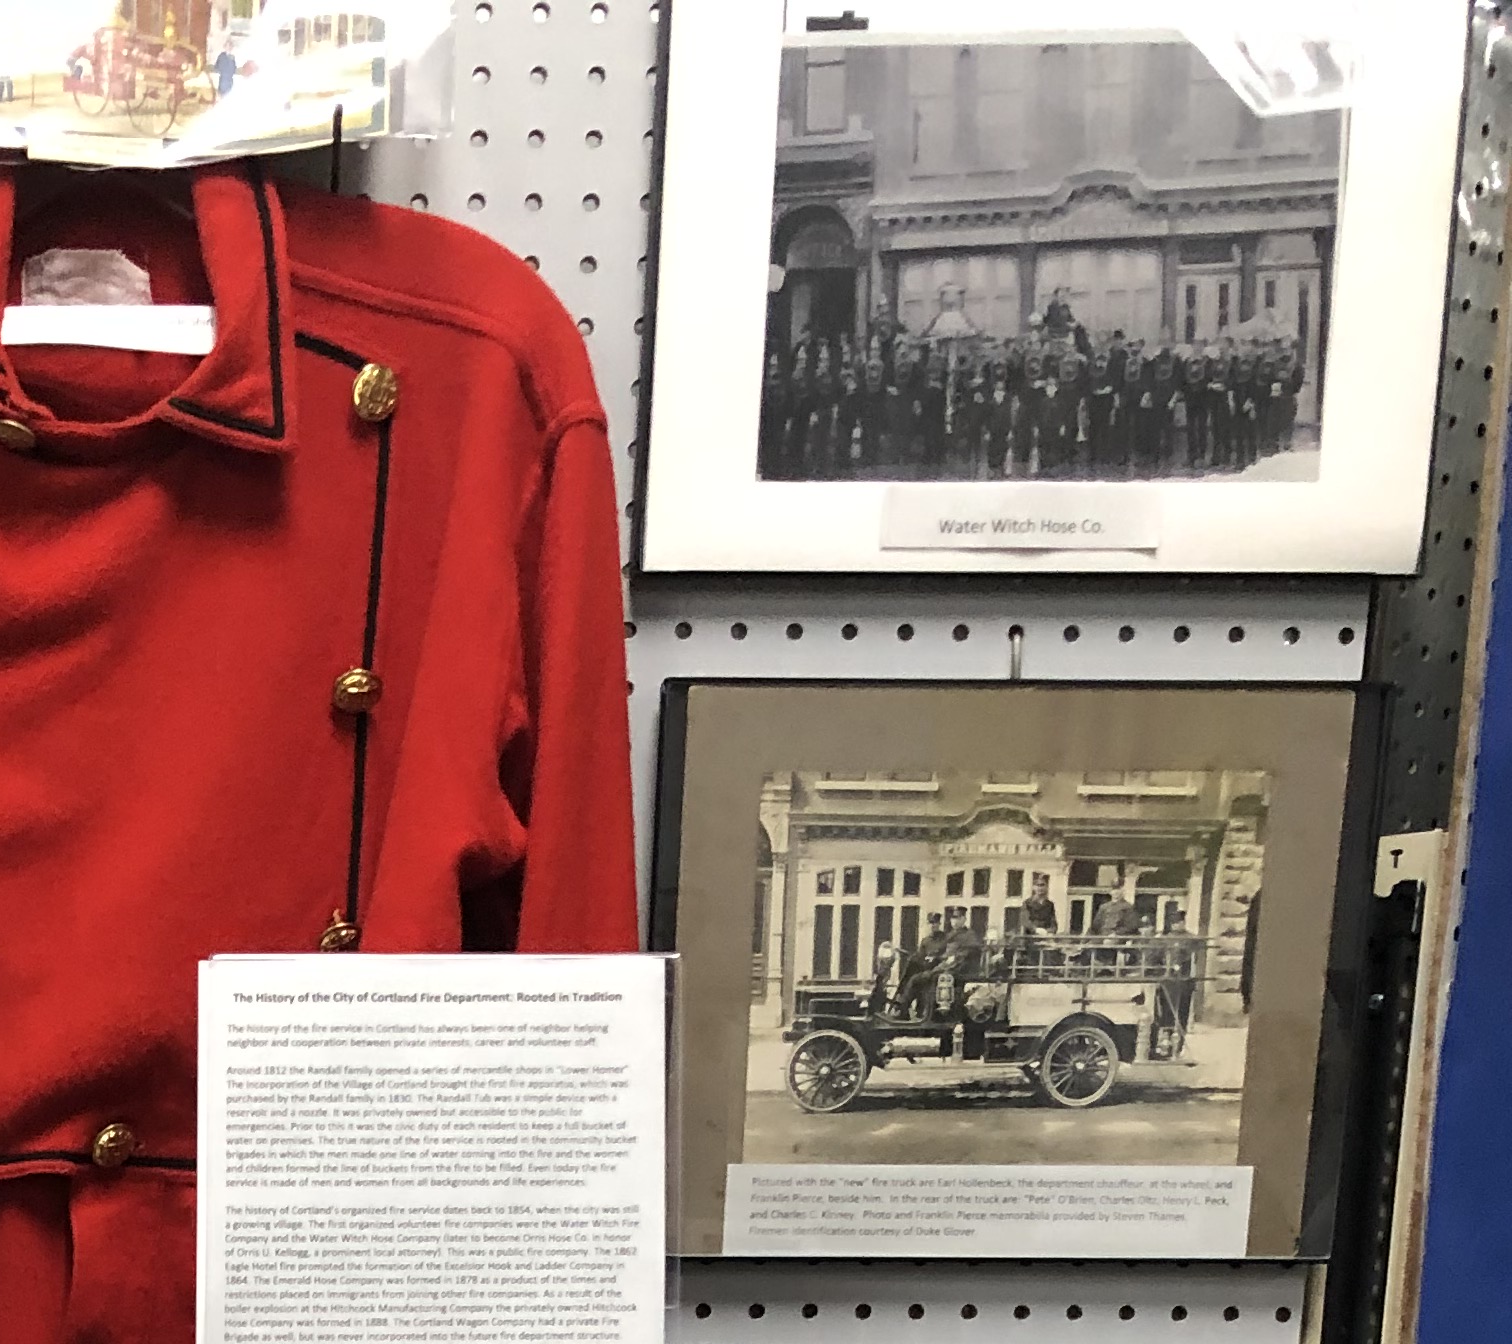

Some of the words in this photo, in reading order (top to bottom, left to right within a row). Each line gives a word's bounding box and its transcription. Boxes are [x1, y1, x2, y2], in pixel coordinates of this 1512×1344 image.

[939, 519, 987, 534] Water
[991, 518, 1036, 533] Witch
[1040, 519, 1077, 534] Hose
[1081, 519, 1105, 534] Co.
[233, 994, 253, 1003] The
[255, 994, 295, 1004] History
[297, 994, 309, 1002] of
[311, 994, 330, 1002] the
[332, 994, 354, 1004] City
[356, 994, 368, 1002] of
[370, 994, 418, 1002] Cortland
[419, 994, 441, 1002] Fire
[516, 993, 556, 1002] Rooted
[558, 993, 569, 1002] in
[572, 993, 622, 1002] Tradition
